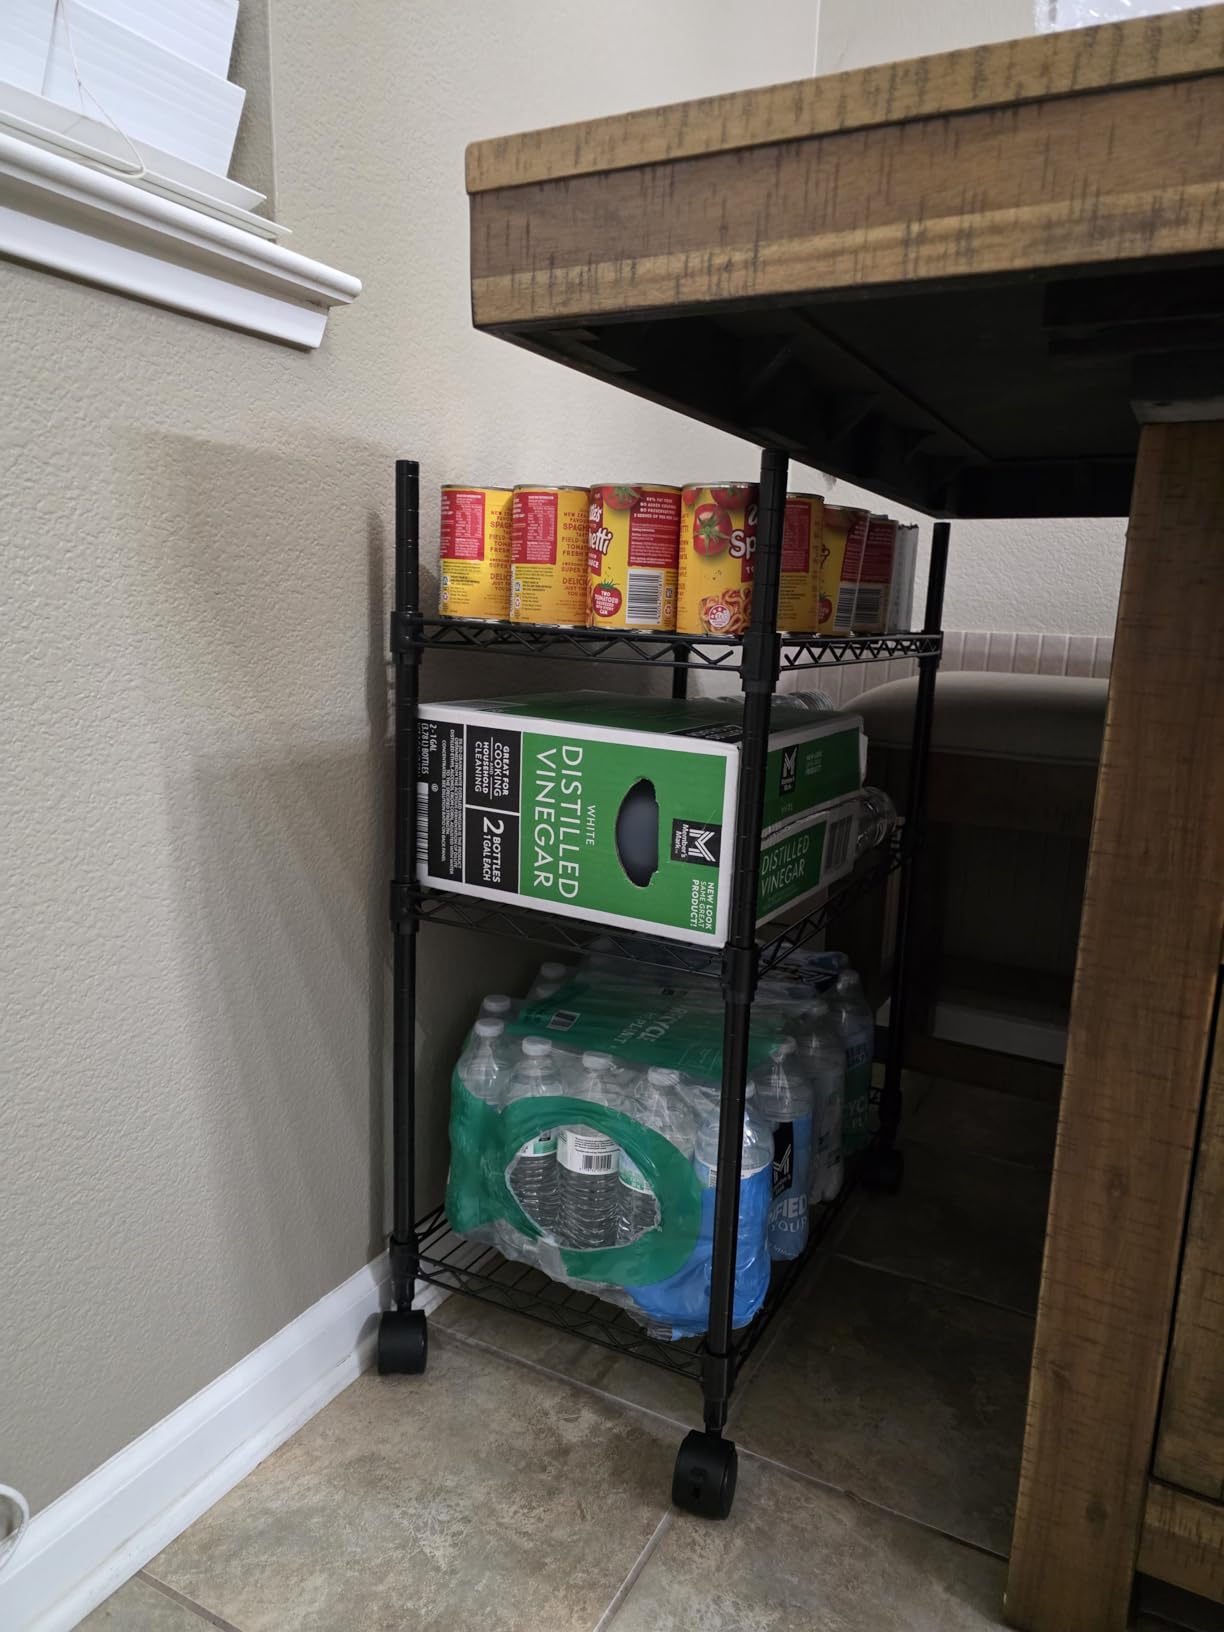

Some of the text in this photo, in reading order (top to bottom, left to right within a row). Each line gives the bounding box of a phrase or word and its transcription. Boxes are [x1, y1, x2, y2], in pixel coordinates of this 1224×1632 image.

[421, 748, 429, 774] BOTTLES
[430, 739, 438, 752] GAL
[475, 741, 483, 792] CLEANING
[502, 746, 510, 775] GREAT
[482, 742, 490, 793] HOUSEHOLD
[494, 743, 503, 796] COOKING
[533, 748, 557, 887] VINEGAR
[558, 745, 583, 898] DISTILLED
[585, 804, 596, 846] WHITE
[483, 839, 491, 856] GAL
[483, 817, 505, 883] 2 BOTTLES
[680, 824, 689, 858] Member's
[761, 835, 810, 875] DISTILLED
[483, 858, 491, 881] EACH
[761, 858, 805, 896] VINEGAR
[690, 879, 699, 927] PRODUCT!
[705, 882, 714, 929] NEW LOOK
